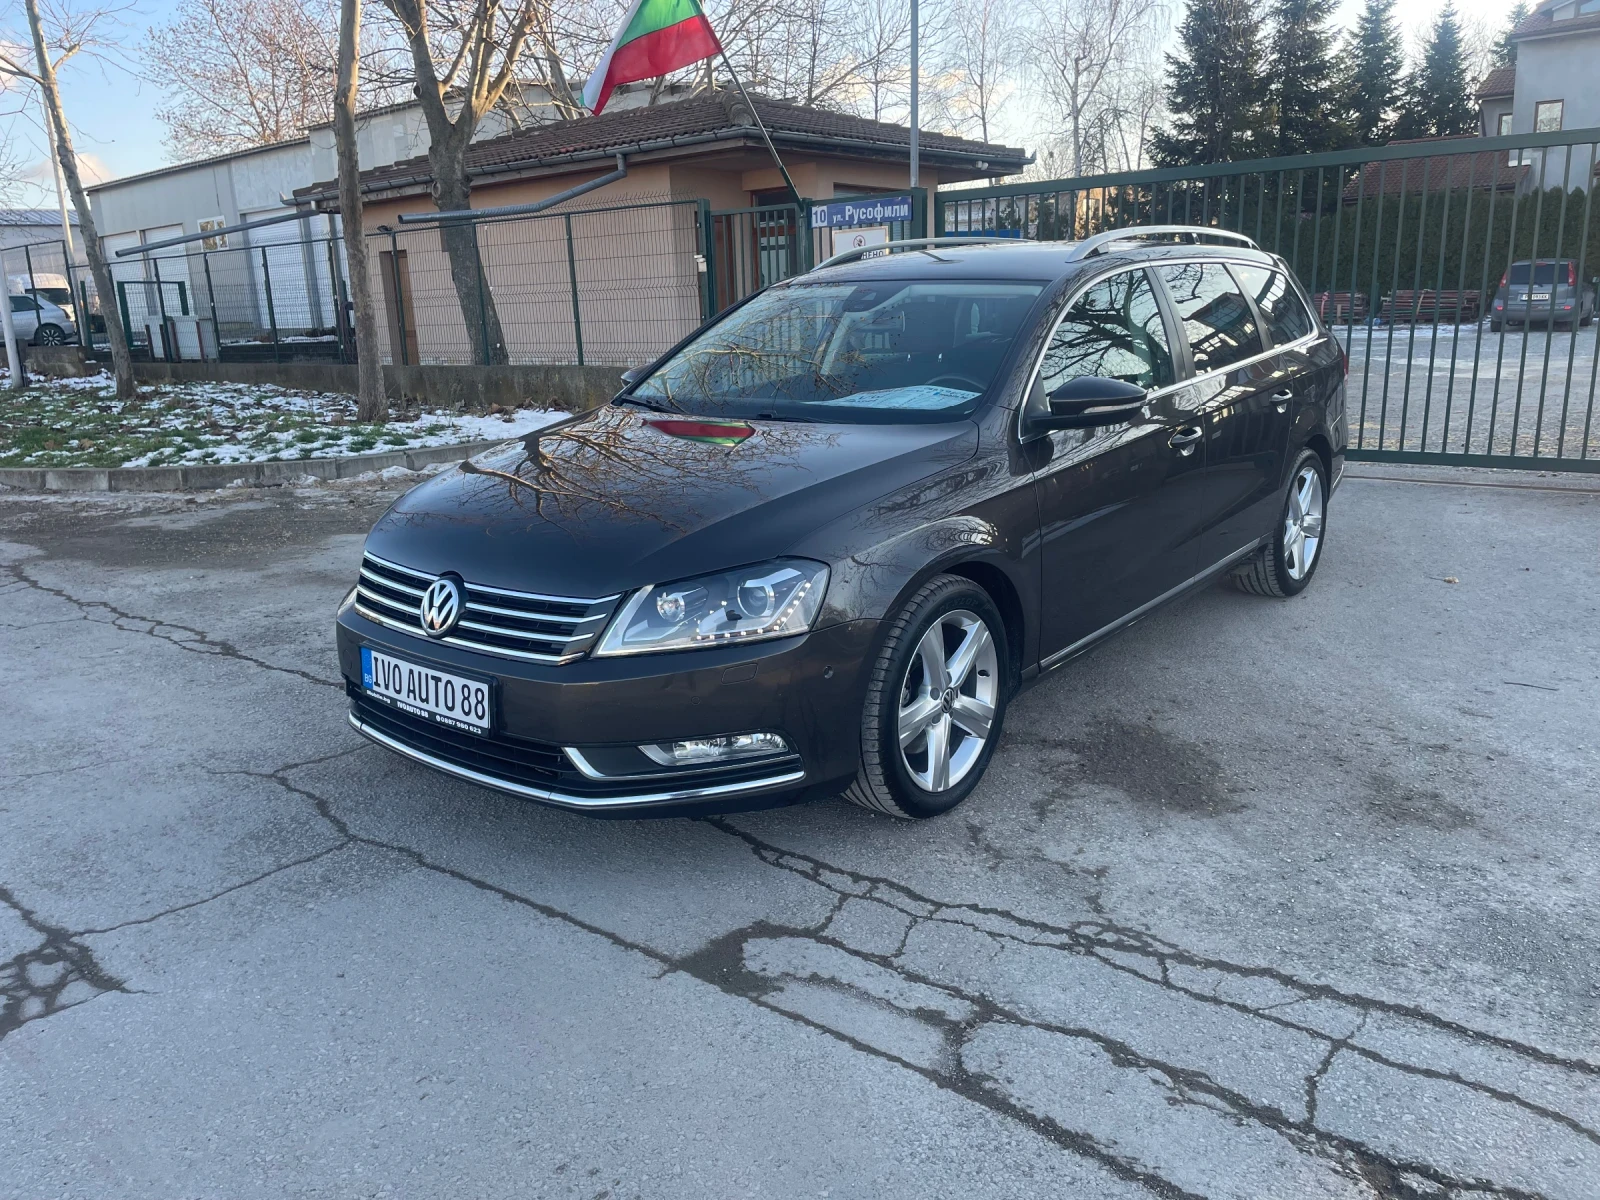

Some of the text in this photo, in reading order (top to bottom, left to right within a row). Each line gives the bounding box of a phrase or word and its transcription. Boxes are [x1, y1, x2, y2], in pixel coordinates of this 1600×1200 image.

[813, 209, 826, 224] 10
[833, 203, 908, 224] ул. Русофили
[364, 673, 372, 684] BG
[373, 656, 486, 720] IVO AUTO 88
